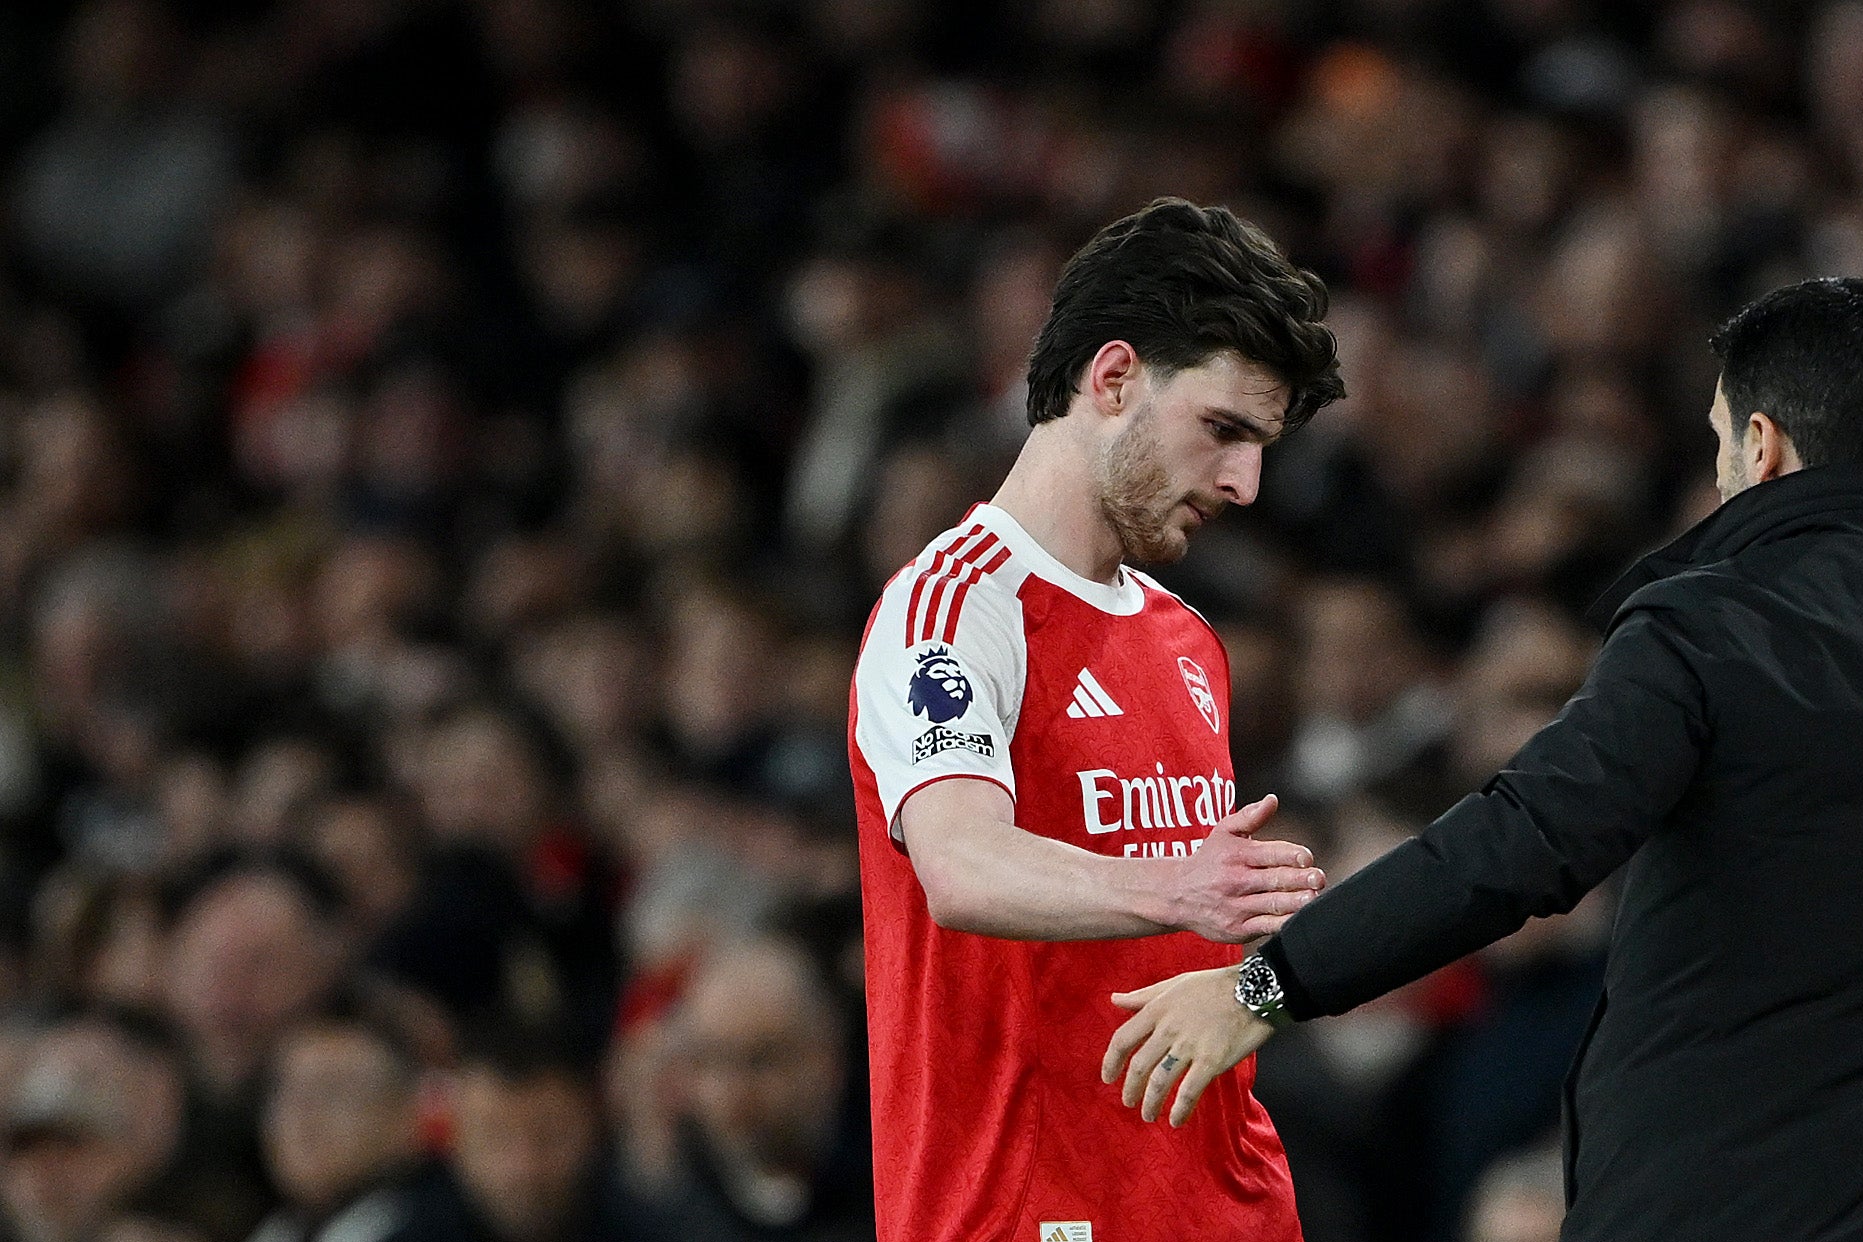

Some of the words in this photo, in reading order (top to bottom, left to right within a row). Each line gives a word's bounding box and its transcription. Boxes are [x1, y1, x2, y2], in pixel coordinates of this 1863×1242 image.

[914, 732, 934, 750] No
[936, 728, 984, 744] room
[936, 738, 994, 757] racism
[1077, 762, 1236, 835] Emirate
